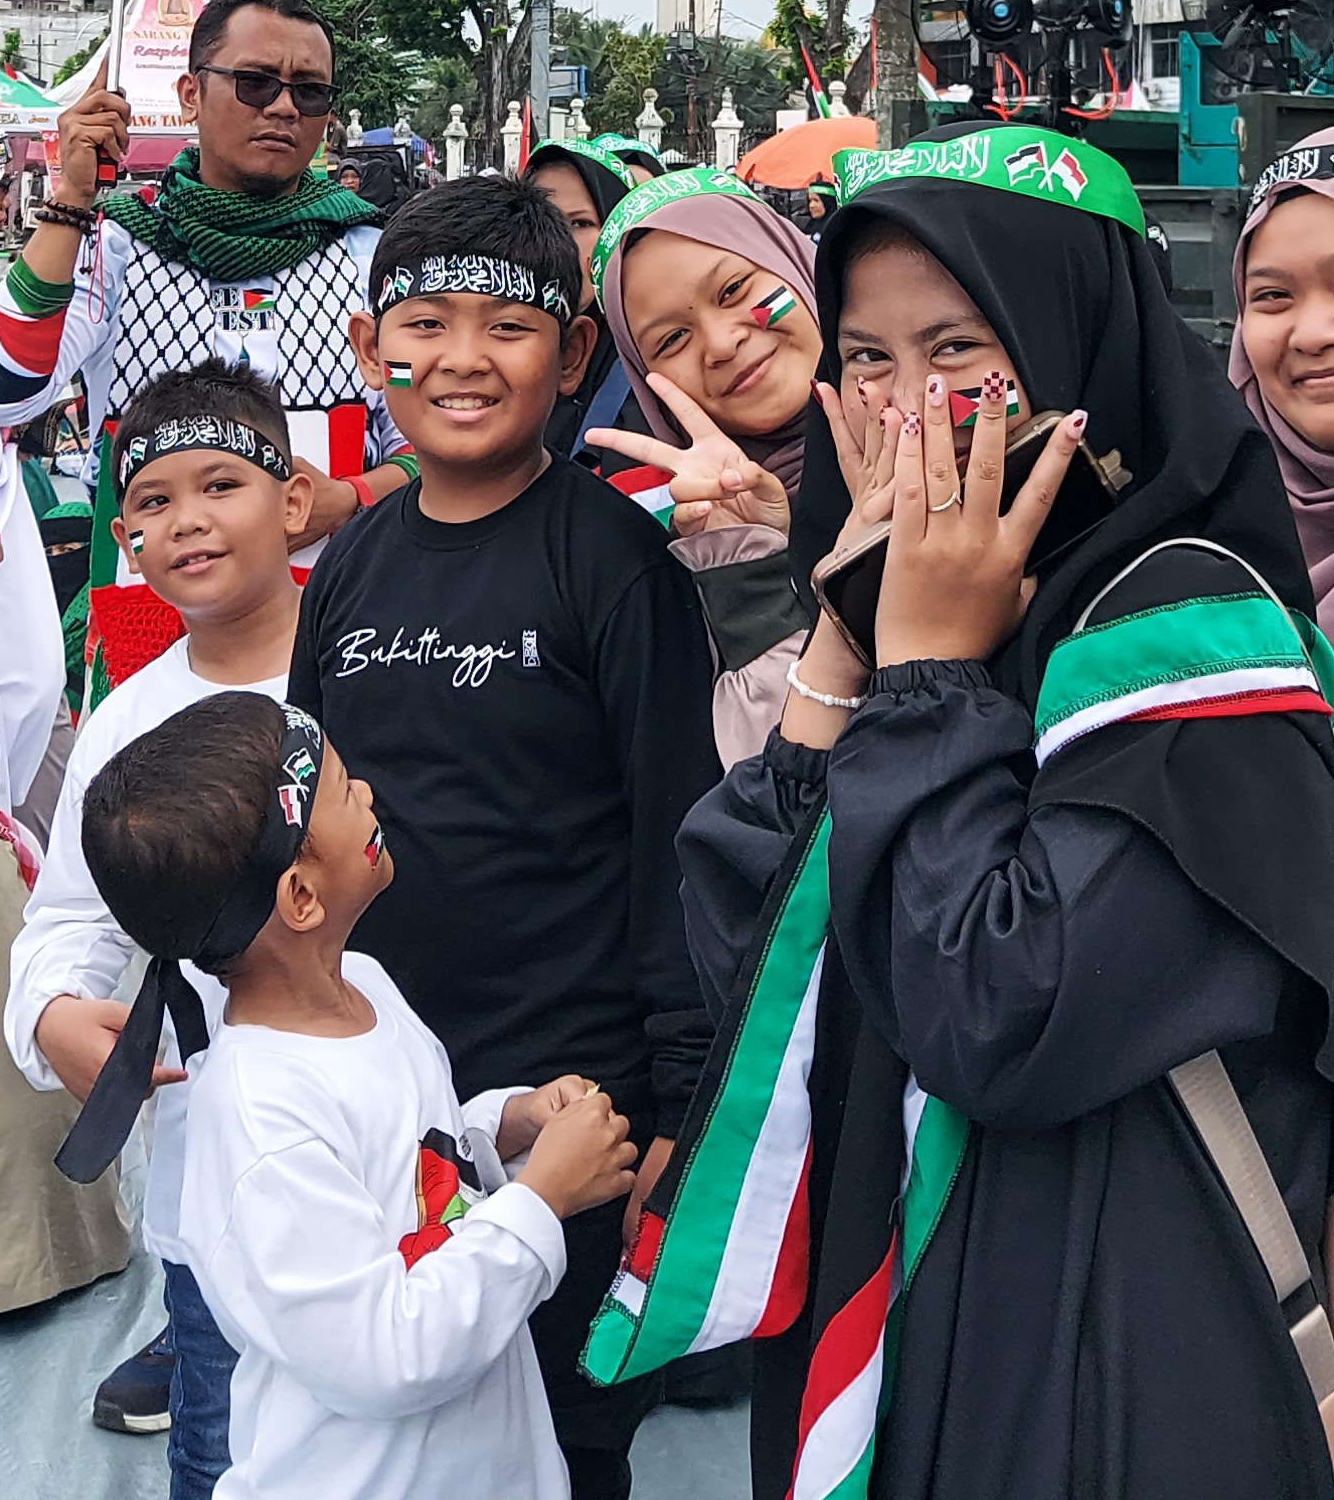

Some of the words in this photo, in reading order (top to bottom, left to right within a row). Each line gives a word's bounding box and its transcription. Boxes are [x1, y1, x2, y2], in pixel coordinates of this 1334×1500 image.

[133, 30, 181, 40] SARANG
[128, 114, 157, 127] ANG
[335, 626, 517, 688] Bukittinggi
